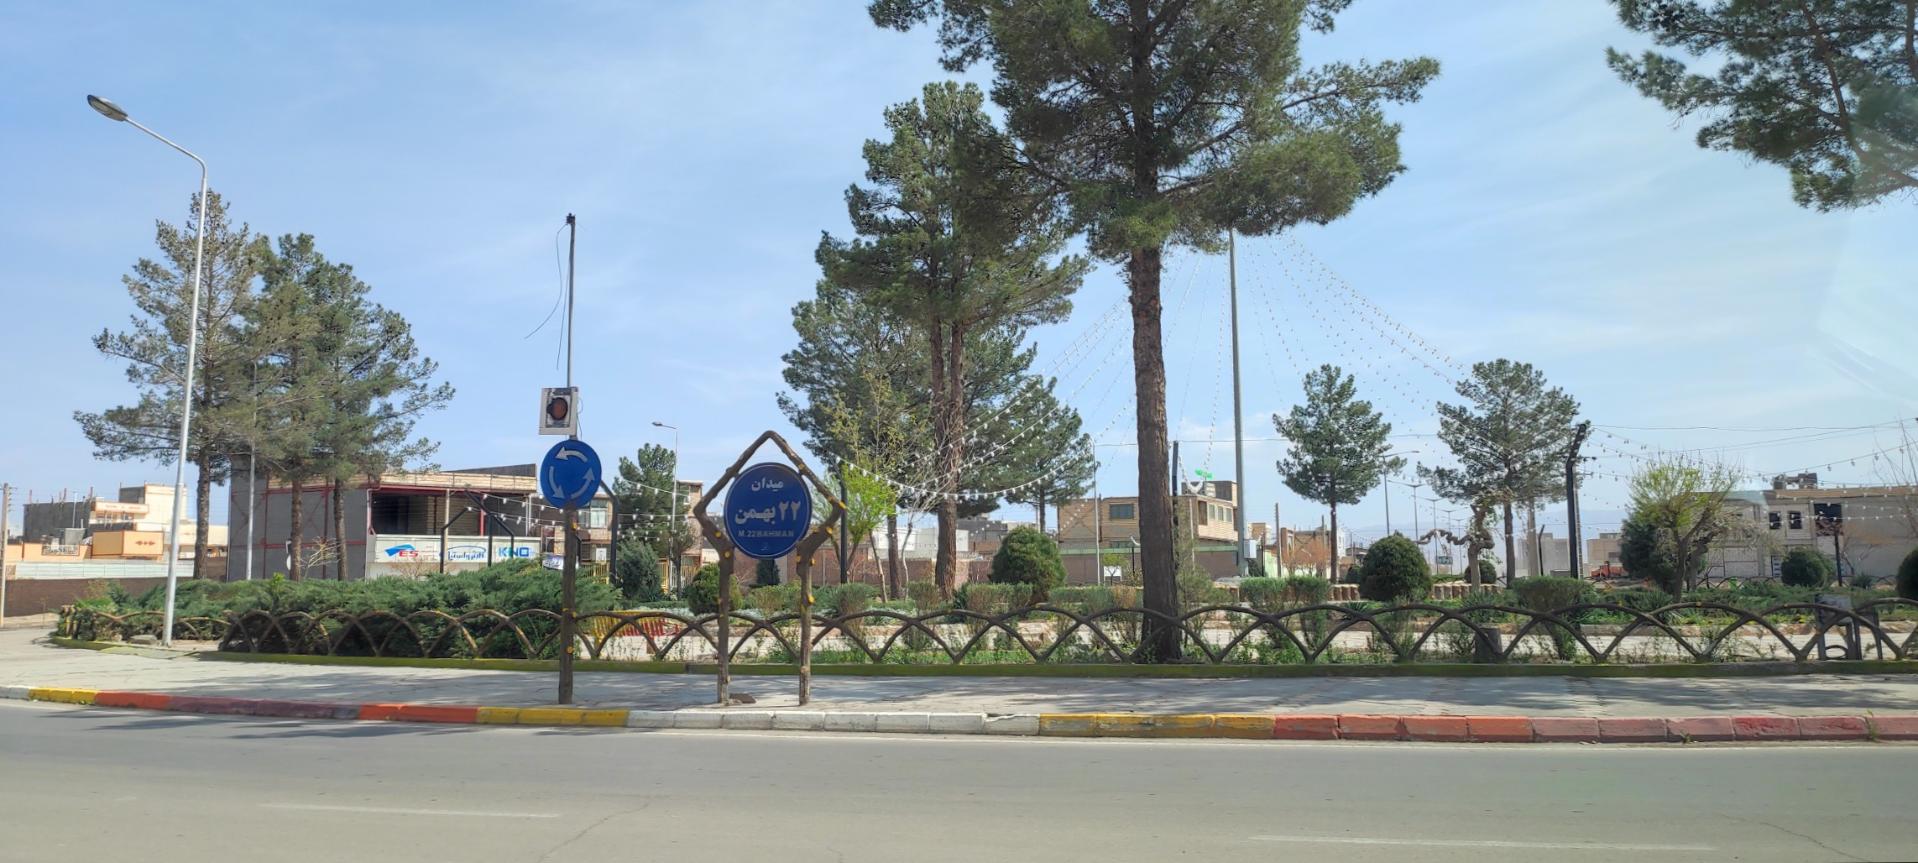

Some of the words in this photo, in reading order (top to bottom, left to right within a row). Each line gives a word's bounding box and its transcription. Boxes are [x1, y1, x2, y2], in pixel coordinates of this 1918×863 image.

[751, 477, 784, 492] میدان
[735, 506, 776, 524] بهمن
[778, 500, 801, 521] ۲۲
